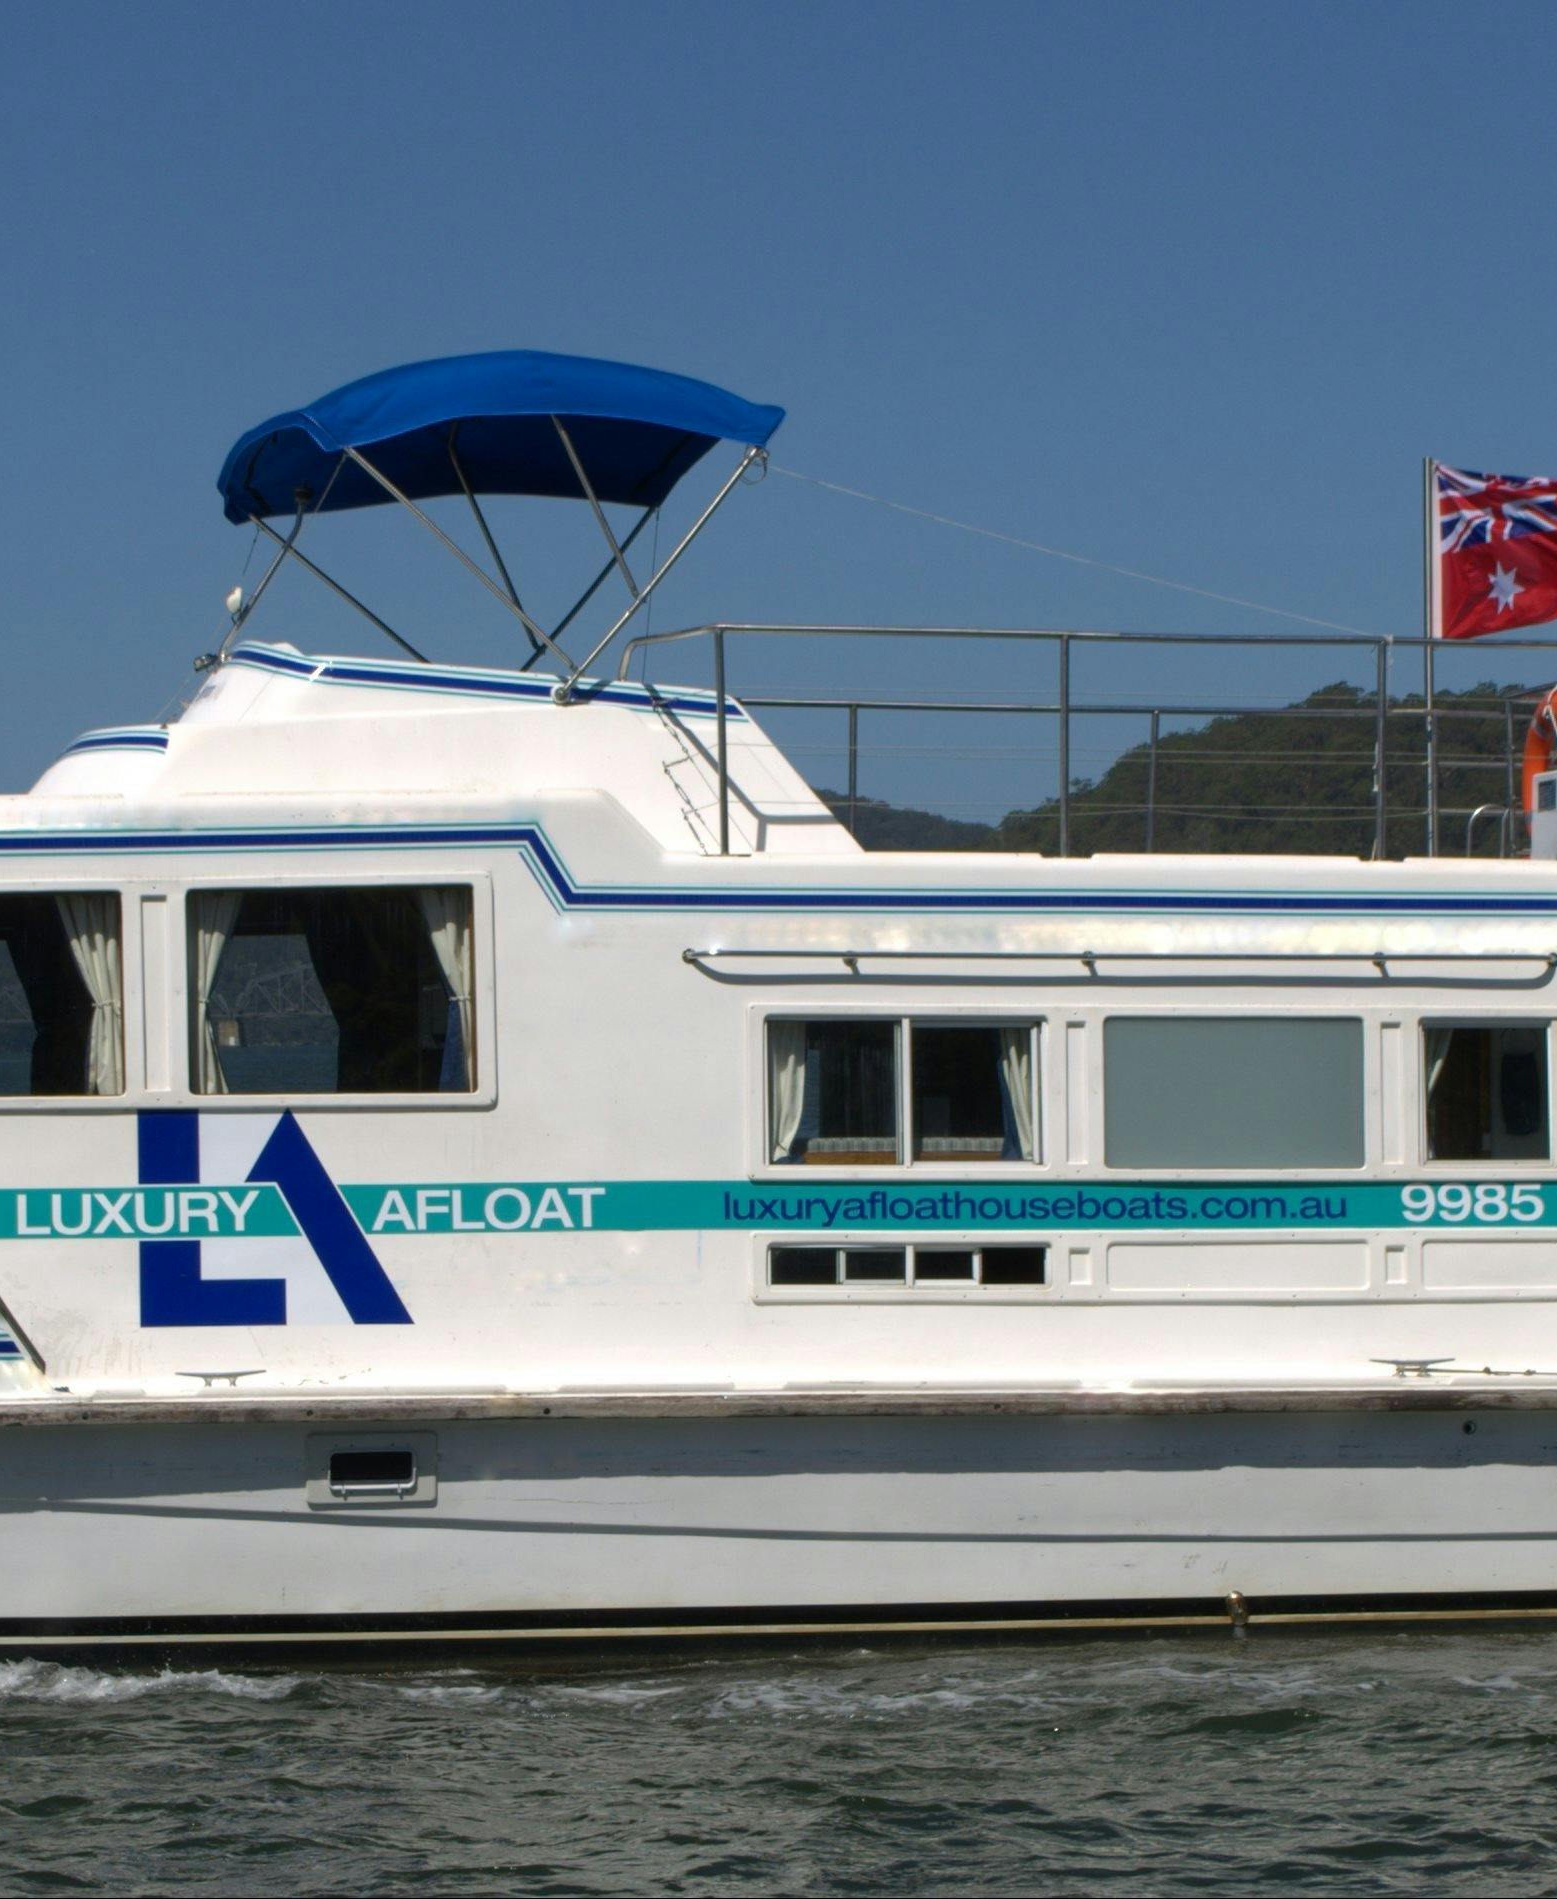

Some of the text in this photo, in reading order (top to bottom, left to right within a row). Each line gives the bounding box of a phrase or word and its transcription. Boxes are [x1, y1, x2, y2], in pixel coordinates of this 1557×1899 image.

[16, 1187, 606, 1235] LUXURY AFLOAT
[723, 1190, 1348, 1228] luxuryafloathouseboats.com.au
[1400, 1182, 1545, 1222] 9985
